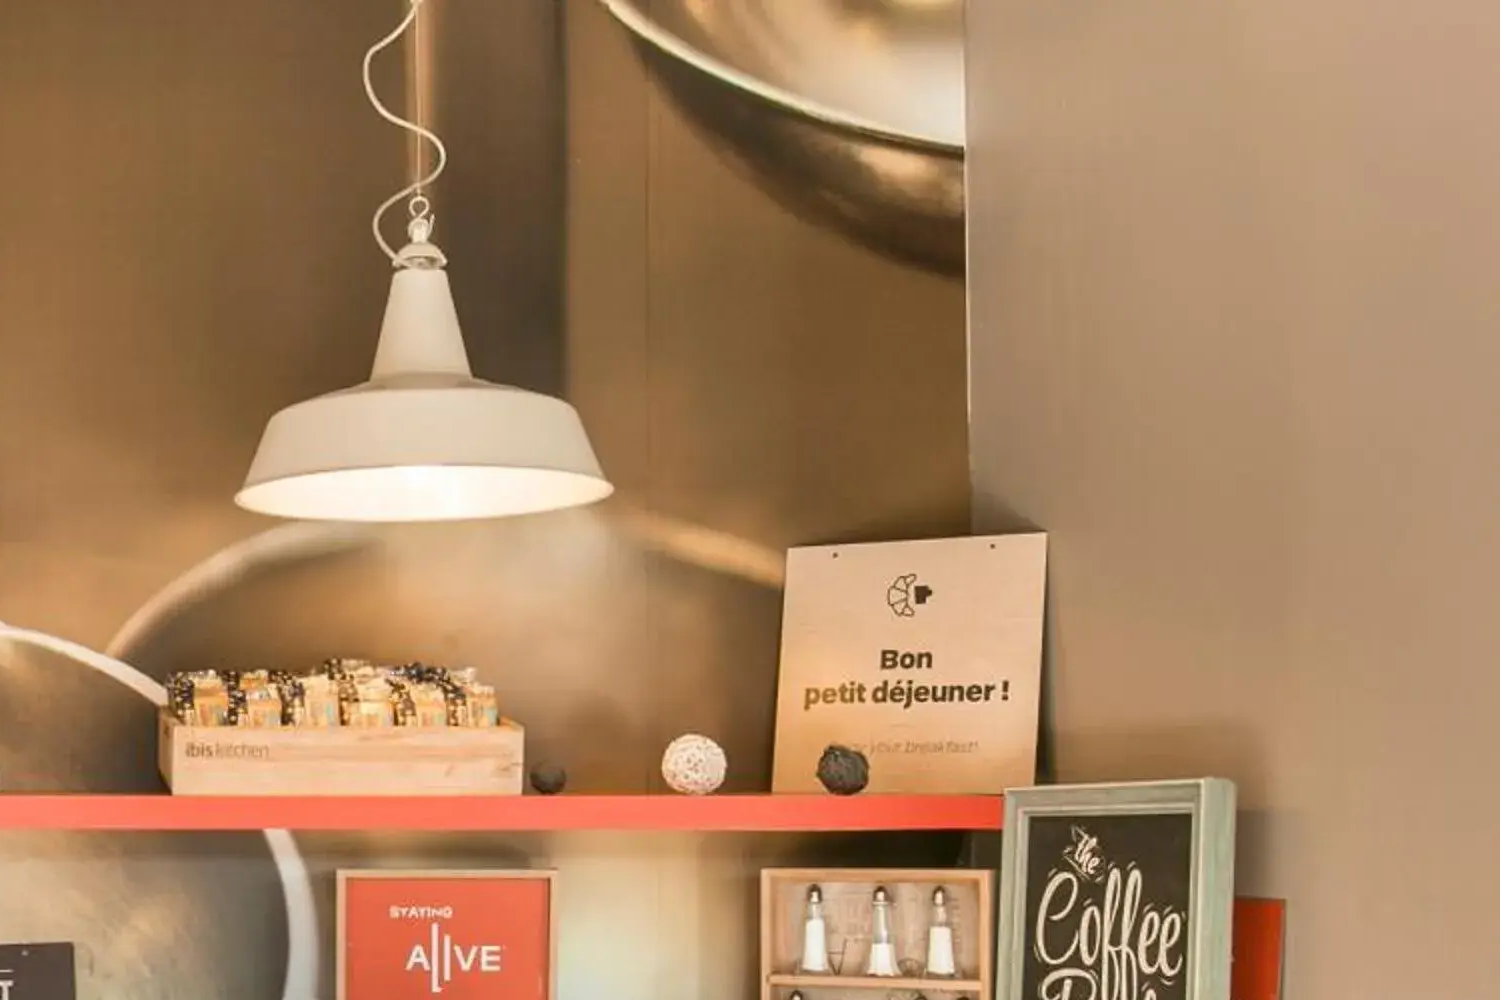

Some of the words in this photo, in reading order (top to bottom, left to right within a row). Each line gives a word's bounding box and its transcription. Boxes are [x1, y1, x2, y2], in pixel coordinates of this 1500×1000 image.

[880, 649, 933, 670] Bon
[804, 682, 867, 711] petit
[871, 680, 996, 709] déjeuner
[185, 742, 213, 758] ibis
[215, 740, 269, 760] kitchen
[1074, 835, 1100, 874] the
[389, 905, 453, 920] STAYING
